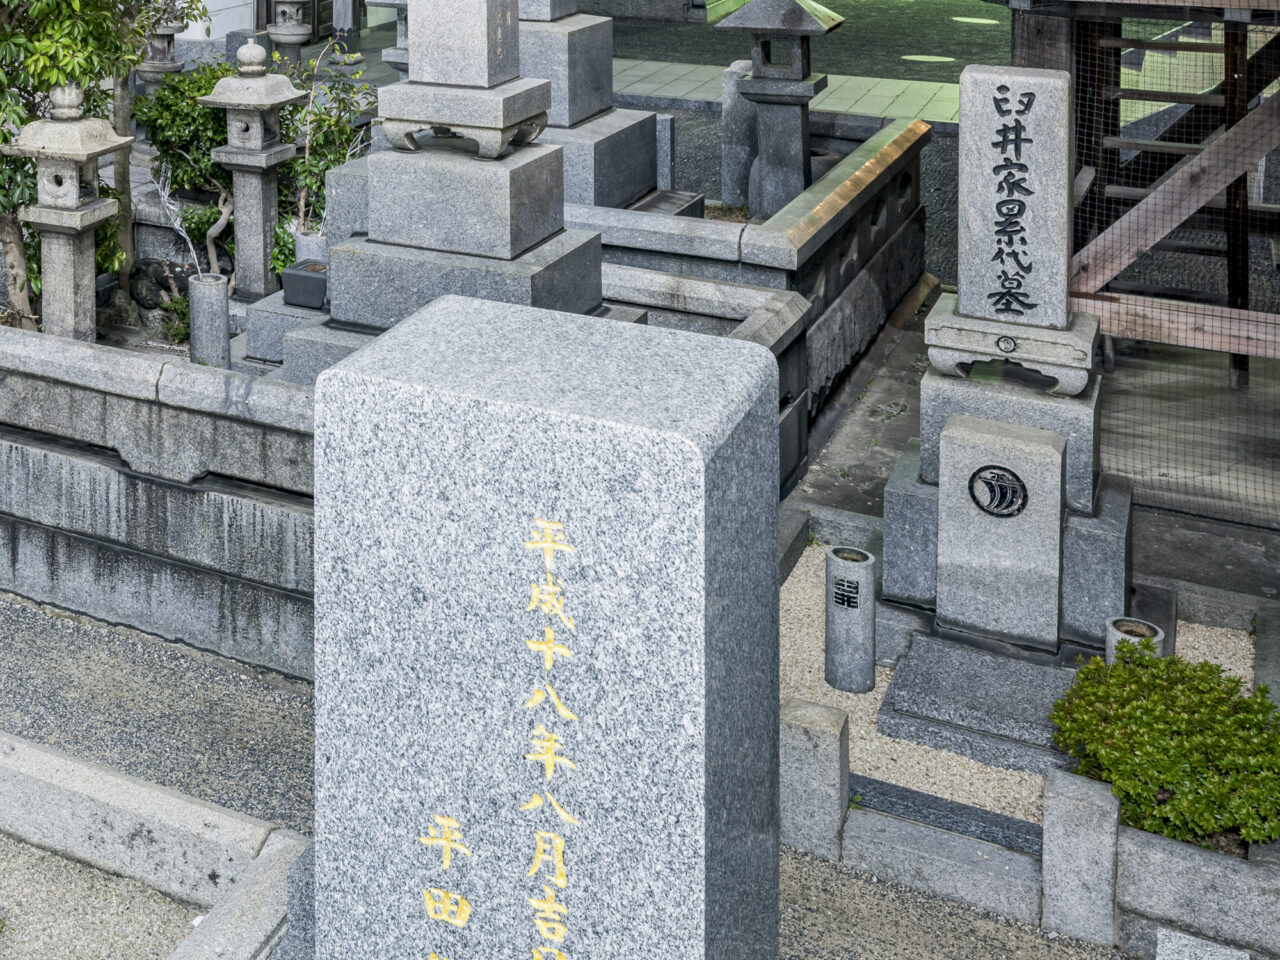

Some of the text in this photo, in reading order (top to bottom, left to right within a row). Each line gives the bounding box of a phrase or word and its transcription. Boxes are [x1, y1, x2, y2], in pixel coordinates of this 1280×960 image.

[521, 518, 579, 960] 平成十八年八月吉
[420, 814, 472, 960] 平田
